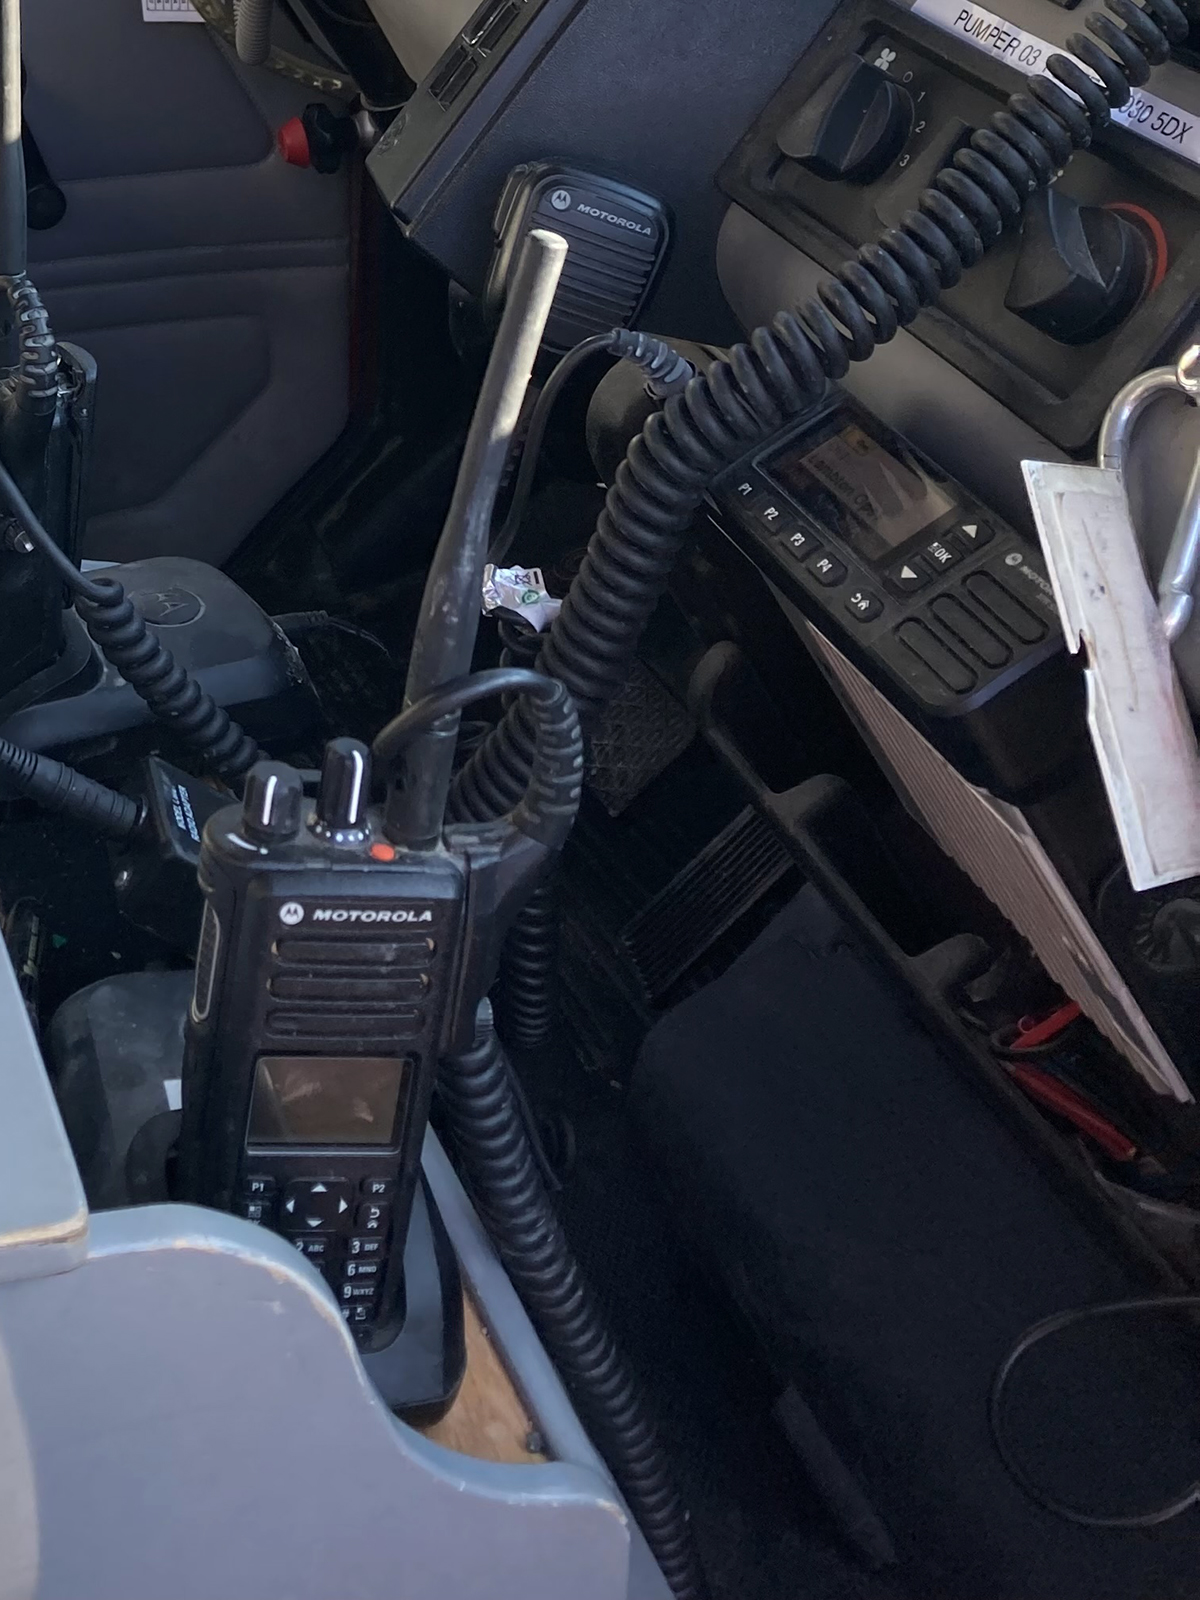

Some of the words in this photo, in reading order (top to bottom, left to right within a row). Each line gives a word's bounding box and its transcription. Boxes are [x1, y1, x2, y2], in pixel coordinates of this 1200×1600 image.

[953, 8, 1022, 58] PUMPER
[1018, 45, 1042, 66] 03
[917, 92, 926, 102] 1
[915, 121, 926, 133] 2
[1150, 111, 1194, 144] 5DX
[900, 154, 910, 167] 3
[576, 203, 651, 236] MOTOROLA
[738, 482, 752, 495] P1
[763, 507, 779, 520] P2
[790, 532, 805, 546] P3
[934, 548, 952, 564] OK
[816, 558, 832, 573] P4
[313, 908, 432, 923] MOTOROLA
[252, 1182, 265, 1192] P1
[372, 1183, 386, 1193] P2
[308, 1244, 324, 1252] ABC
[351, 1241, 360, 1254] 3
[364, 1243, 379, 1251] DEF
[347, 1264, 356, 1276] 6
[358, 1265, 377, 1273] MNO
[343, 1285, 352, 1299] 9
[352, 1287, 374, 1296] WXYZ
